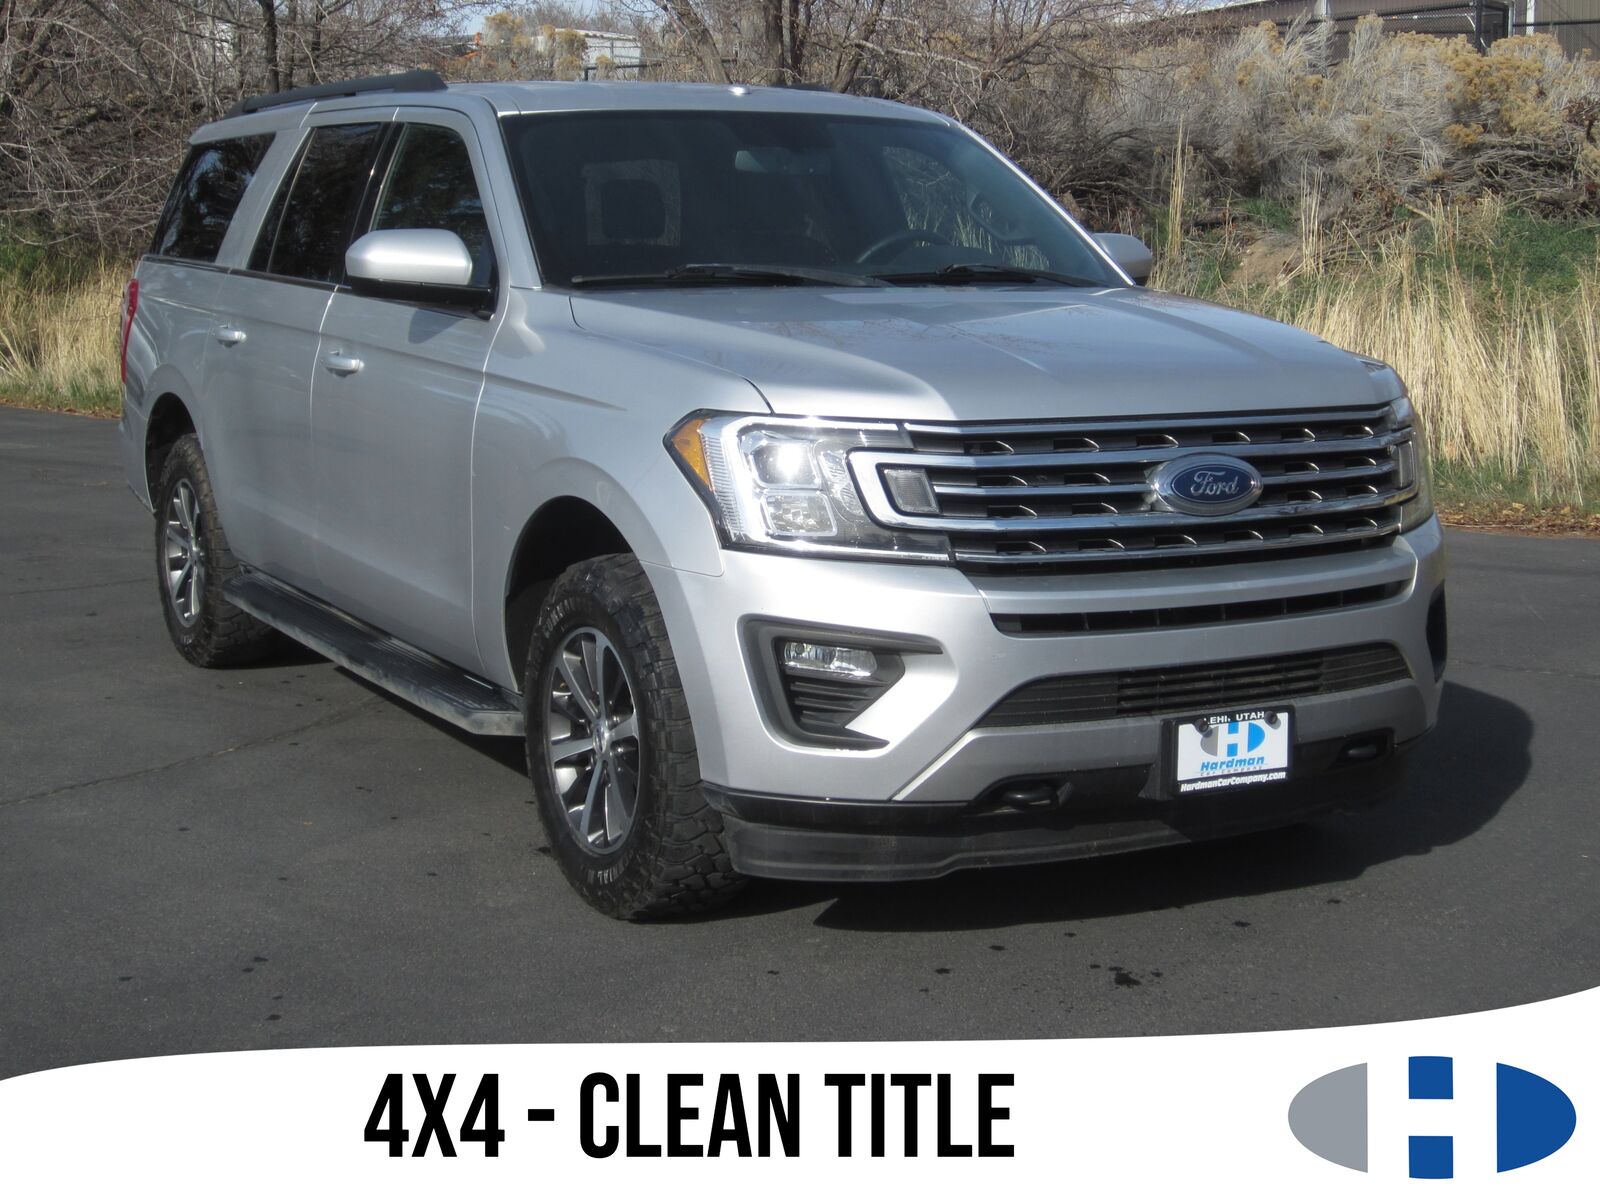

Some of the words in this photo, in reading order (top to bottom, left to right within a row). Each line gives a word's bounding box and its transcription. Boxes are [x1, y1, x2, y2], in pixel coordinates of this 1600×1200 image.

[1190, 470, 1240, 497] Ford
[1236, 711, 1265, 721] UTAH
[1200, 756, 1265, 771] Hardman
[1180, 772, 1286, 792] HardmanCarCompany.com
